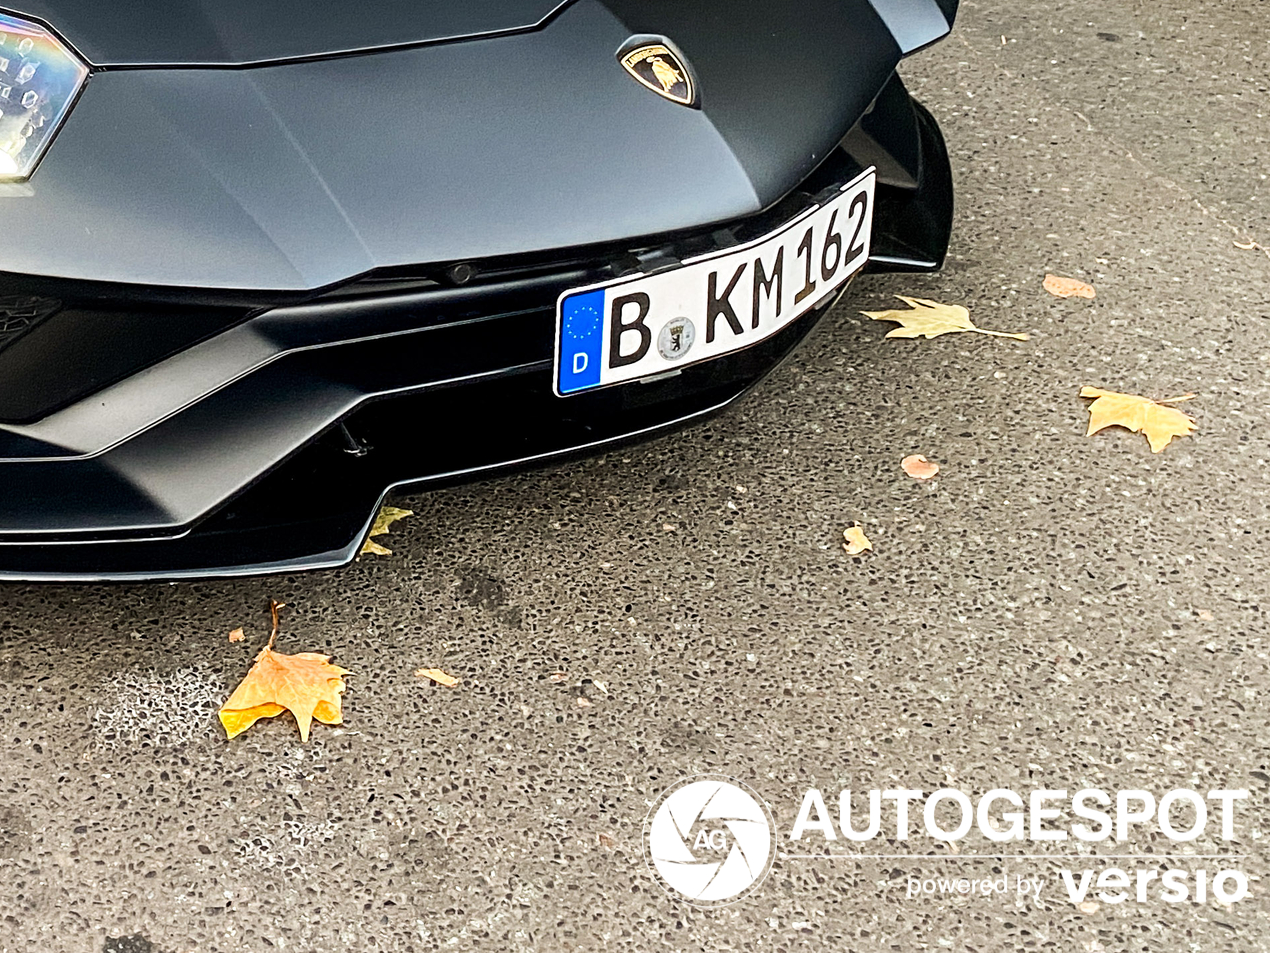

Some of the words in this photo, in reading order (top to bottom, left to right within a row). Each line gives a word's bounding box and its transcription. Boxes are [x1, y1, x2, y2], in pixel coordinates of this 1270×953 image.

[609, 292, 652, 369] B
[706, 246, 784, 344] KM
[794, 191, 868, 305] 162
[573, 352, 588, 374] D
